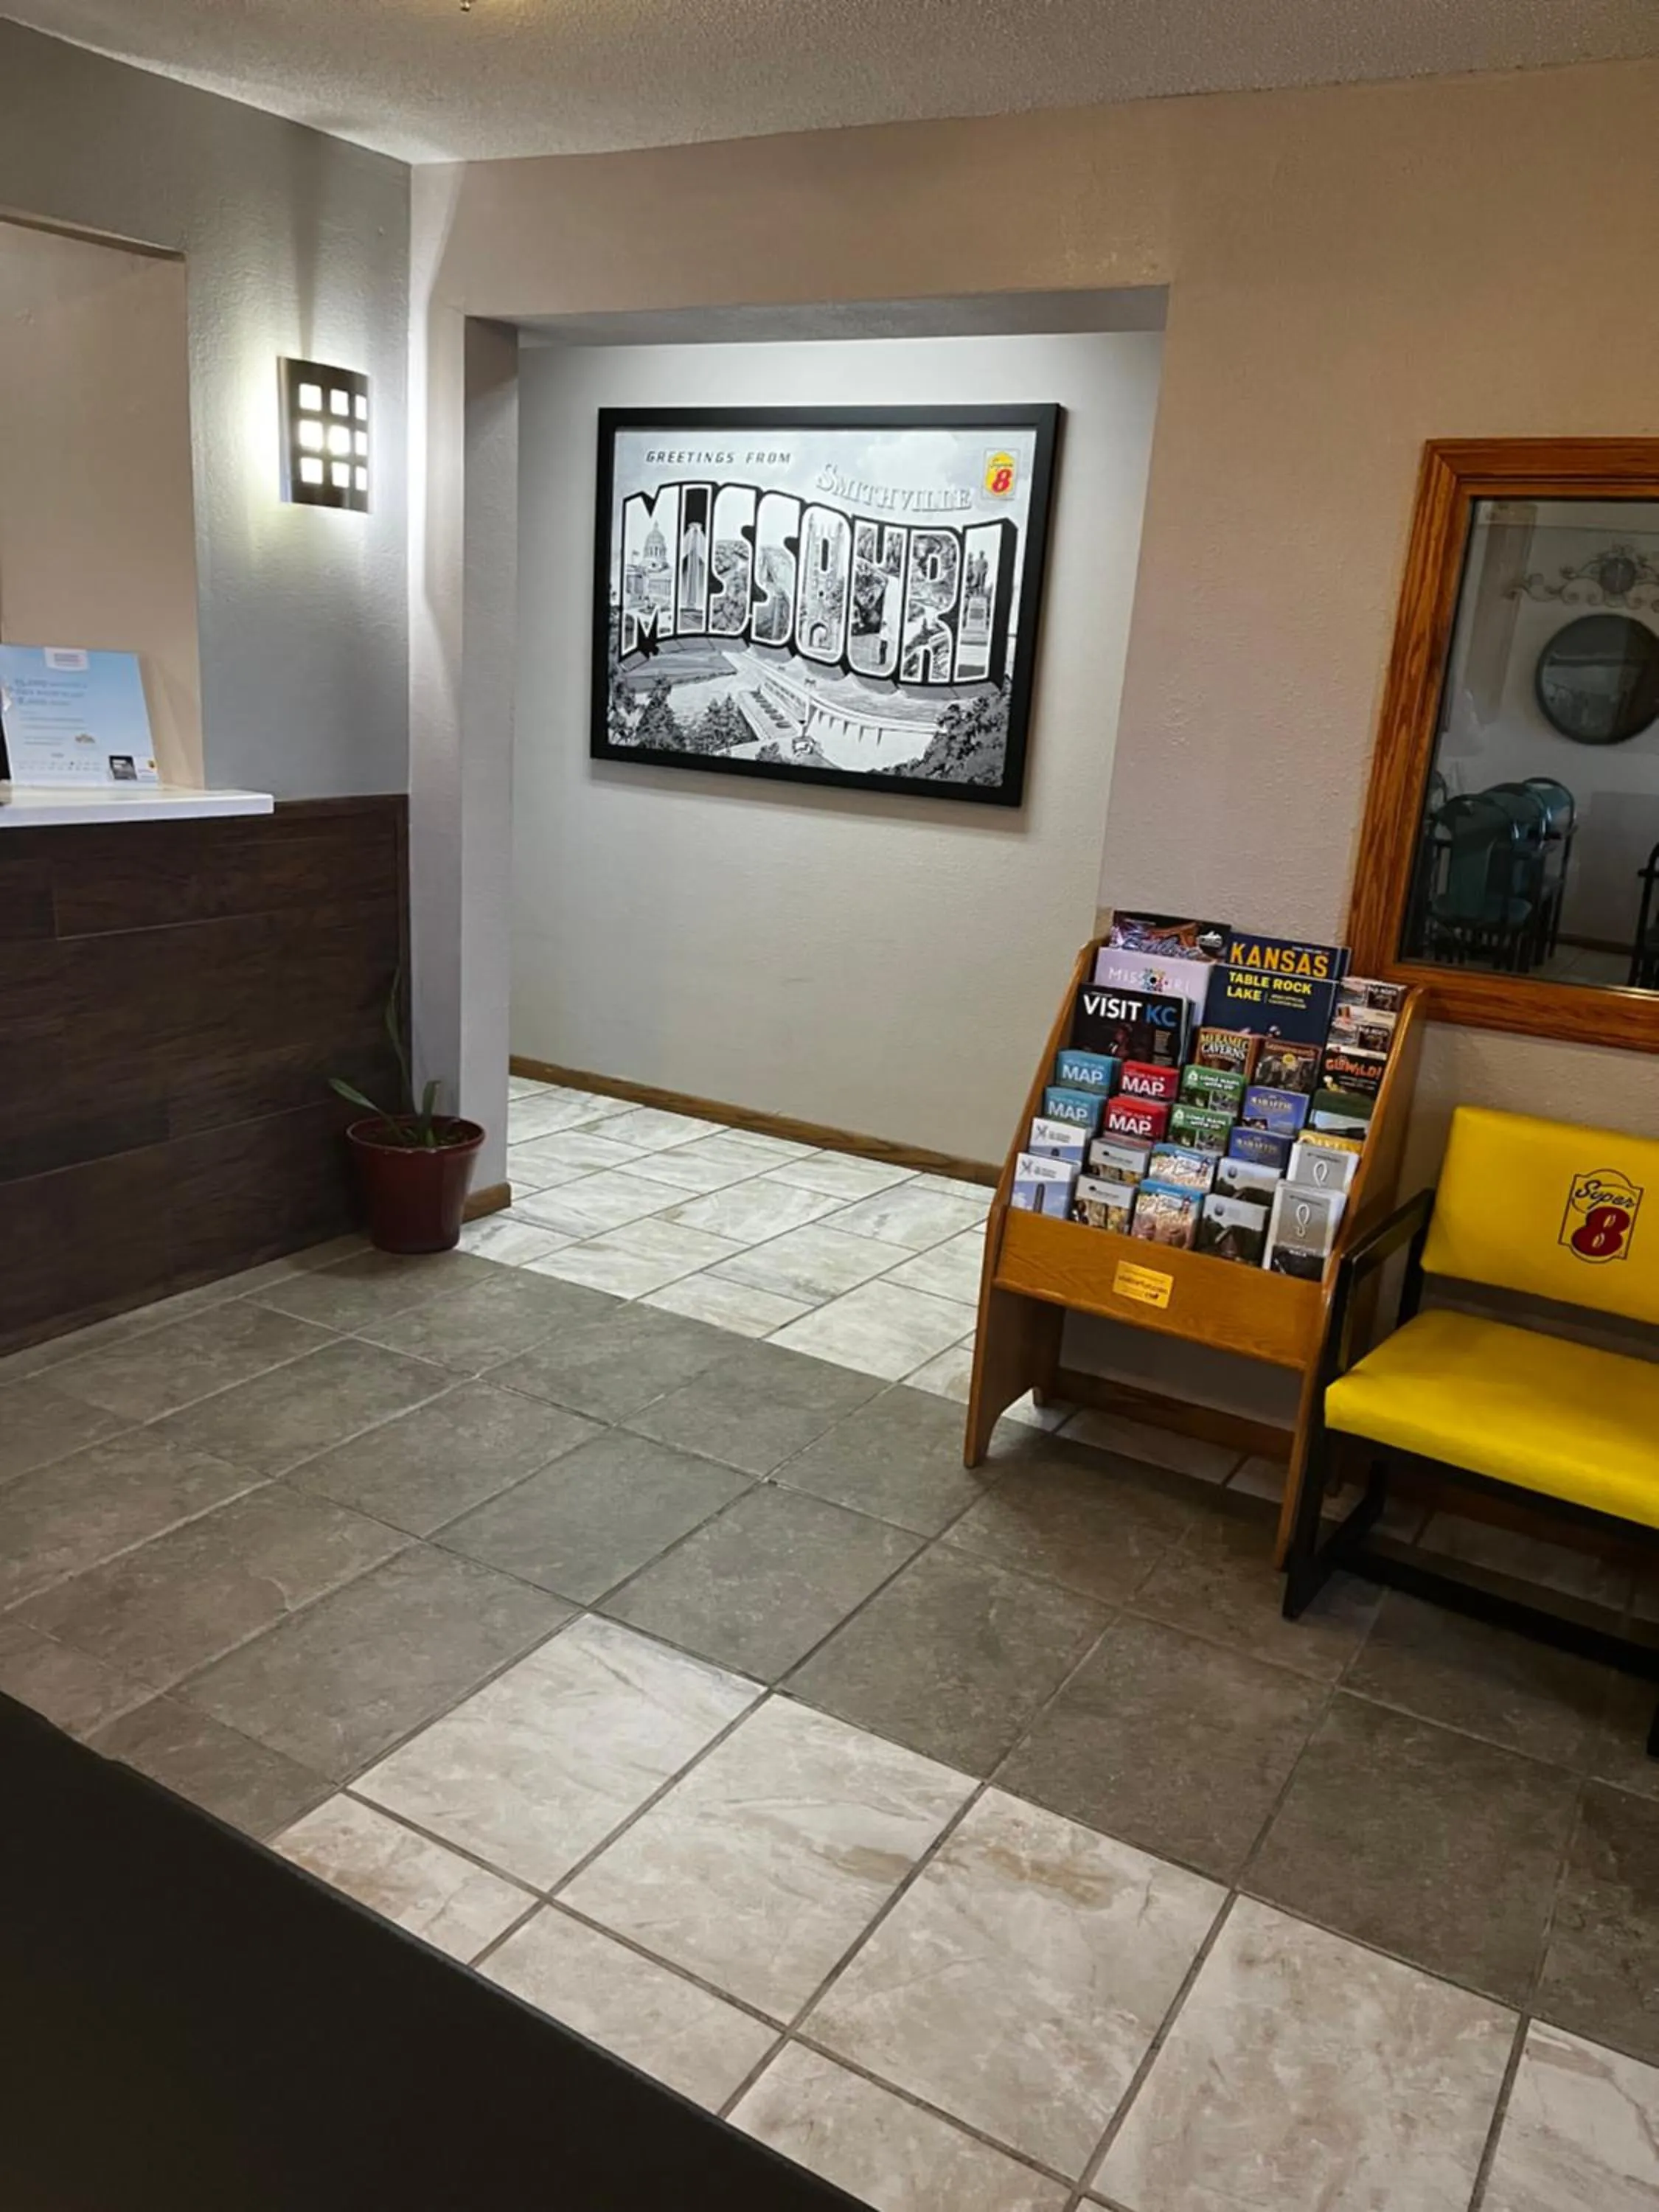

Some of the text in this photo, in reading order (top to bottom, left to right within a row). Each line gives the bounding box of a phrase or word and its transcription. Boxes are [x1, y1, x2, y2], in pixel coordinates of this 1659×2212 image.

[646, 450, 792, 465] GREETINGS FROM
[991, 468, 1012, 493] 8
[619, 481, 1016, 687] MISSOURI
[1230, 942, 1329, 978] KANSAS
[1227, 985, 1262, 1002] LAKE
[1229, 971, 1312, 995] TABLE ROCK
[1083, 995, 1178, 1027] VISIT KC
[1201, 1042, 1246, 1060] CAVERNS
[1062, 1064, 1104, 1085] MAP
[1121, 1075, 1165, 1096] MAP
[1048, 1100, 1088, 1121] MAP
[1108, 1113, 1152, 1135] MAP
[1575, 1179, 1635, 1210] Super
[1571, 1206, 1630, 1256] 8
